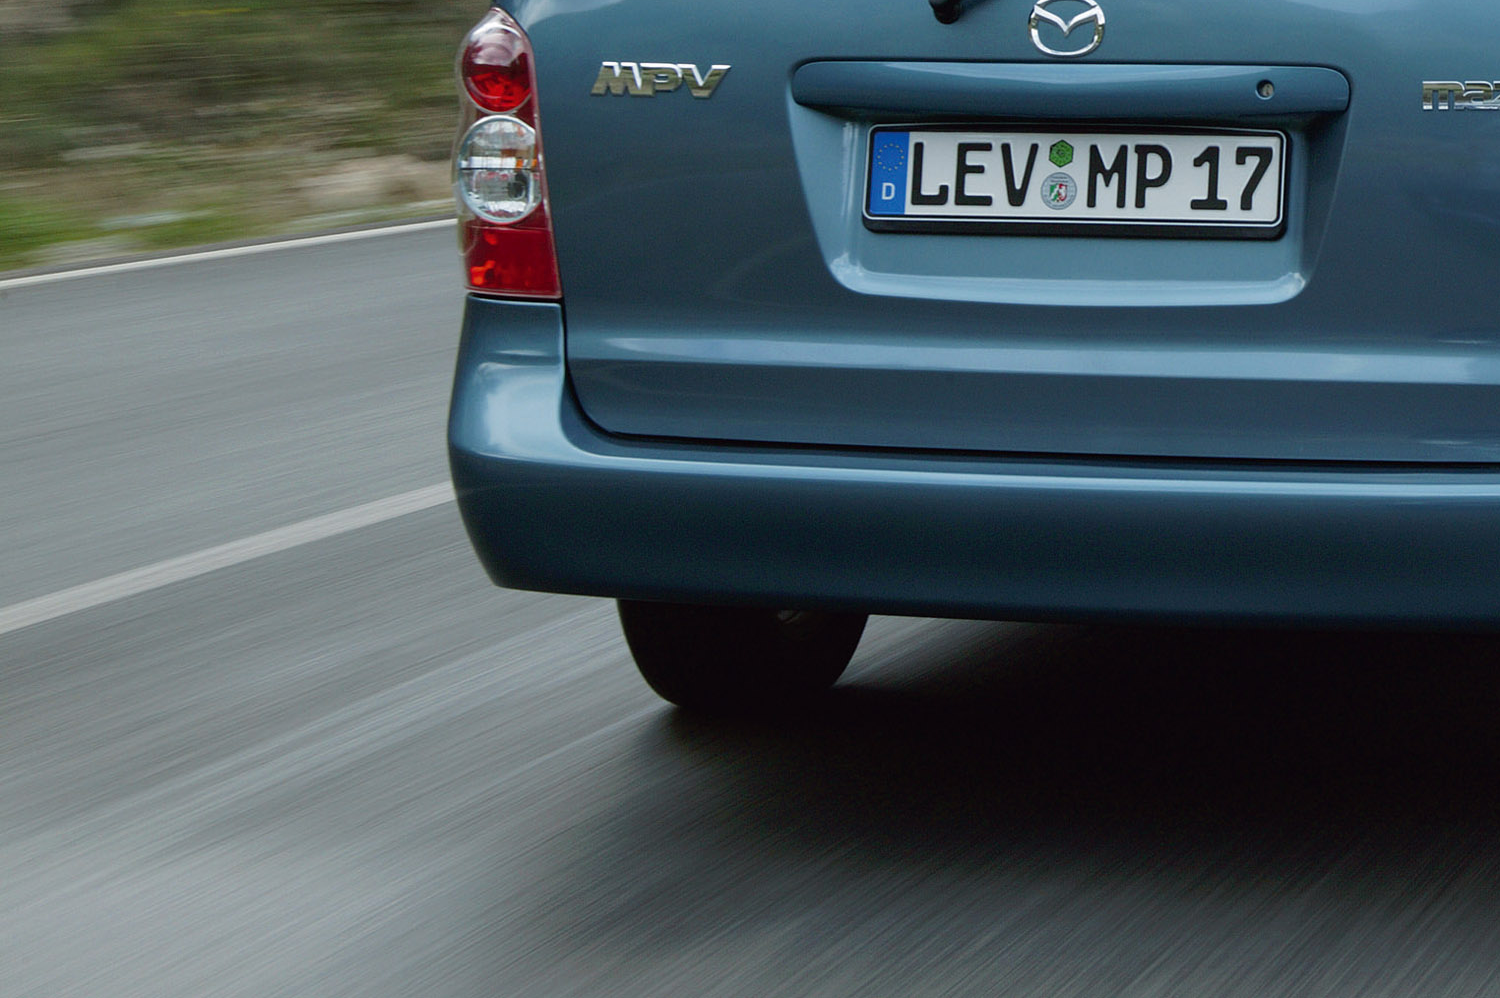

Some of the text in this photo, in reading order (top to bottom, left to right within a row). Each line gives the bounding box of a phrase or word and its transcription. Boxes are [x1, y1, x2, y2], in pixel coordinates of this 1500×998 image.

[590, 61, 732, 99] MPV
[881, 182, 896, 201] D
[911, 142, 1274, 211] LEV MP 17
